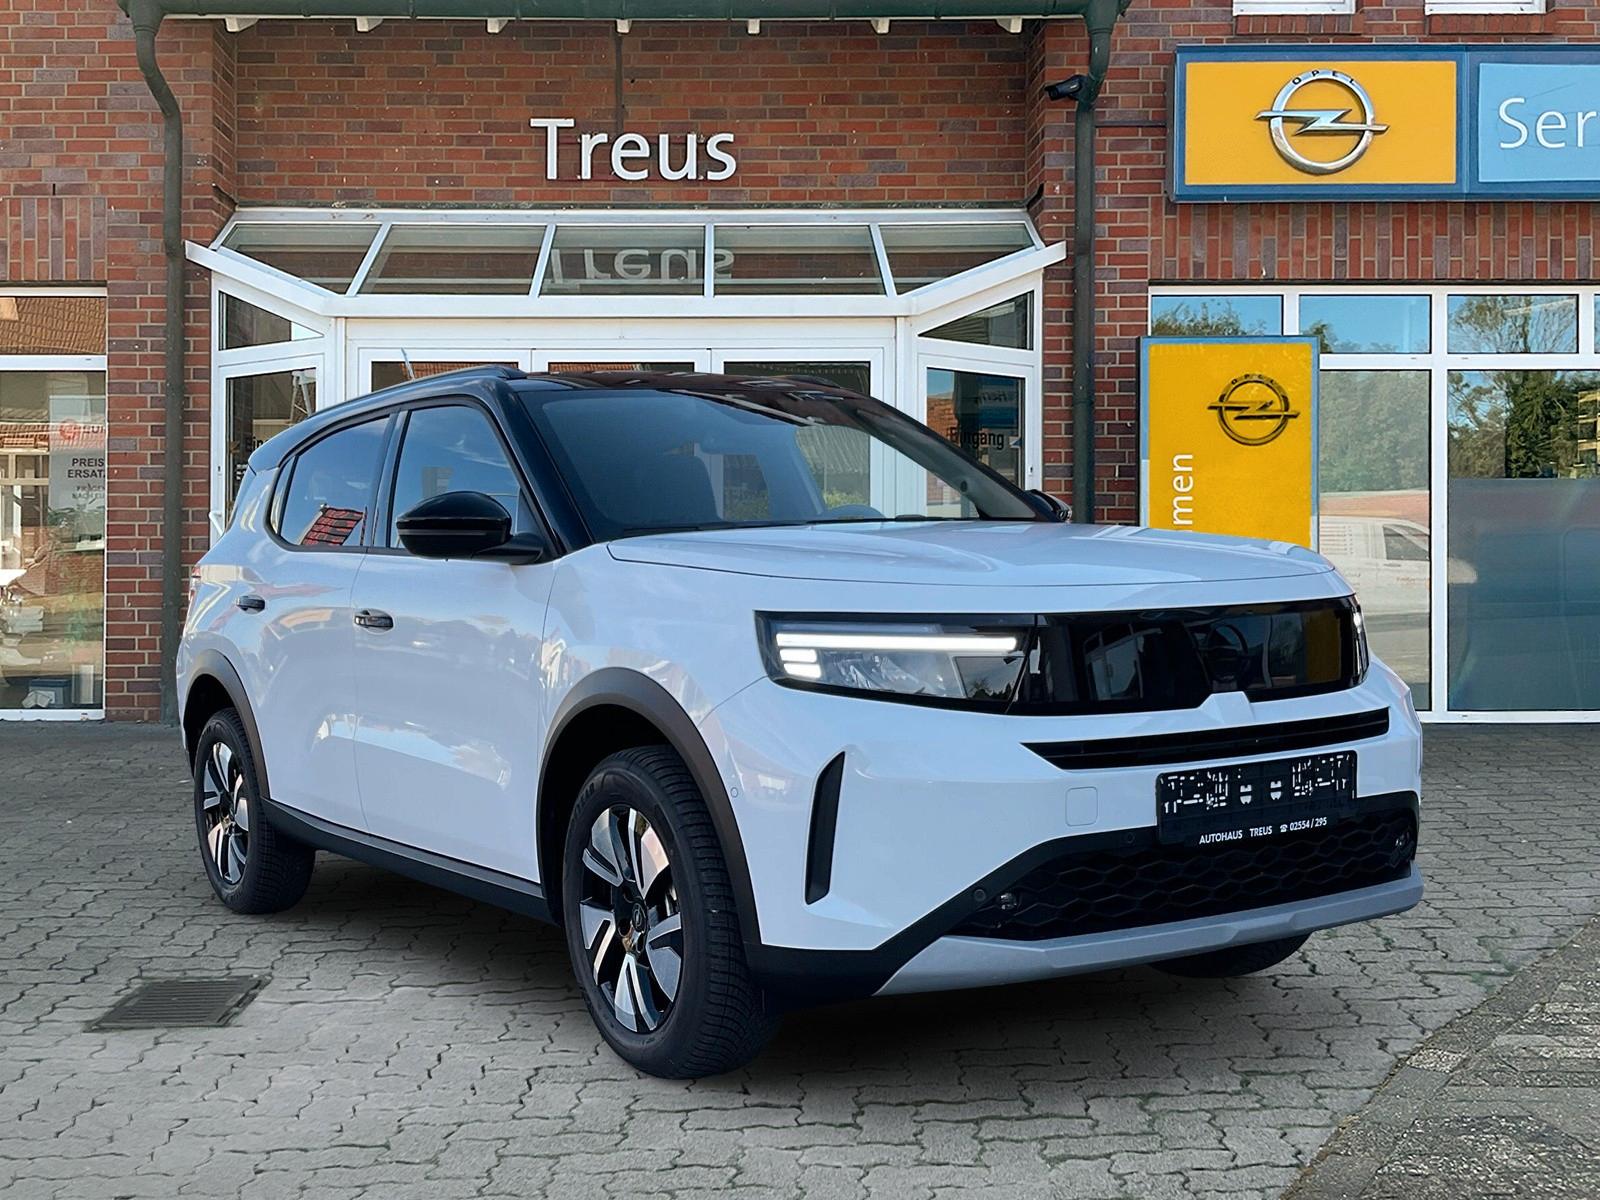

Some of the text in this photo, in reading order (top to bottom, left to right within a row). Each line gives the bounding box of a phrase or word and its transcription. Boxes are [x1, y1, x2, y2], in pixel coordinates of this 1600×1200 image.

[1291, 69, 1357, 86] OPEL
[1498, 96, 1598, 150] Ser
[530, 117, 738, 182] Treus
[72, 458, 105, 467] PREIS
[1171, 453, 1195, 531] men
[1199, 830, 1243, 845] AUTOHAUS
[1249, 826, 1273, 837] TREUS
